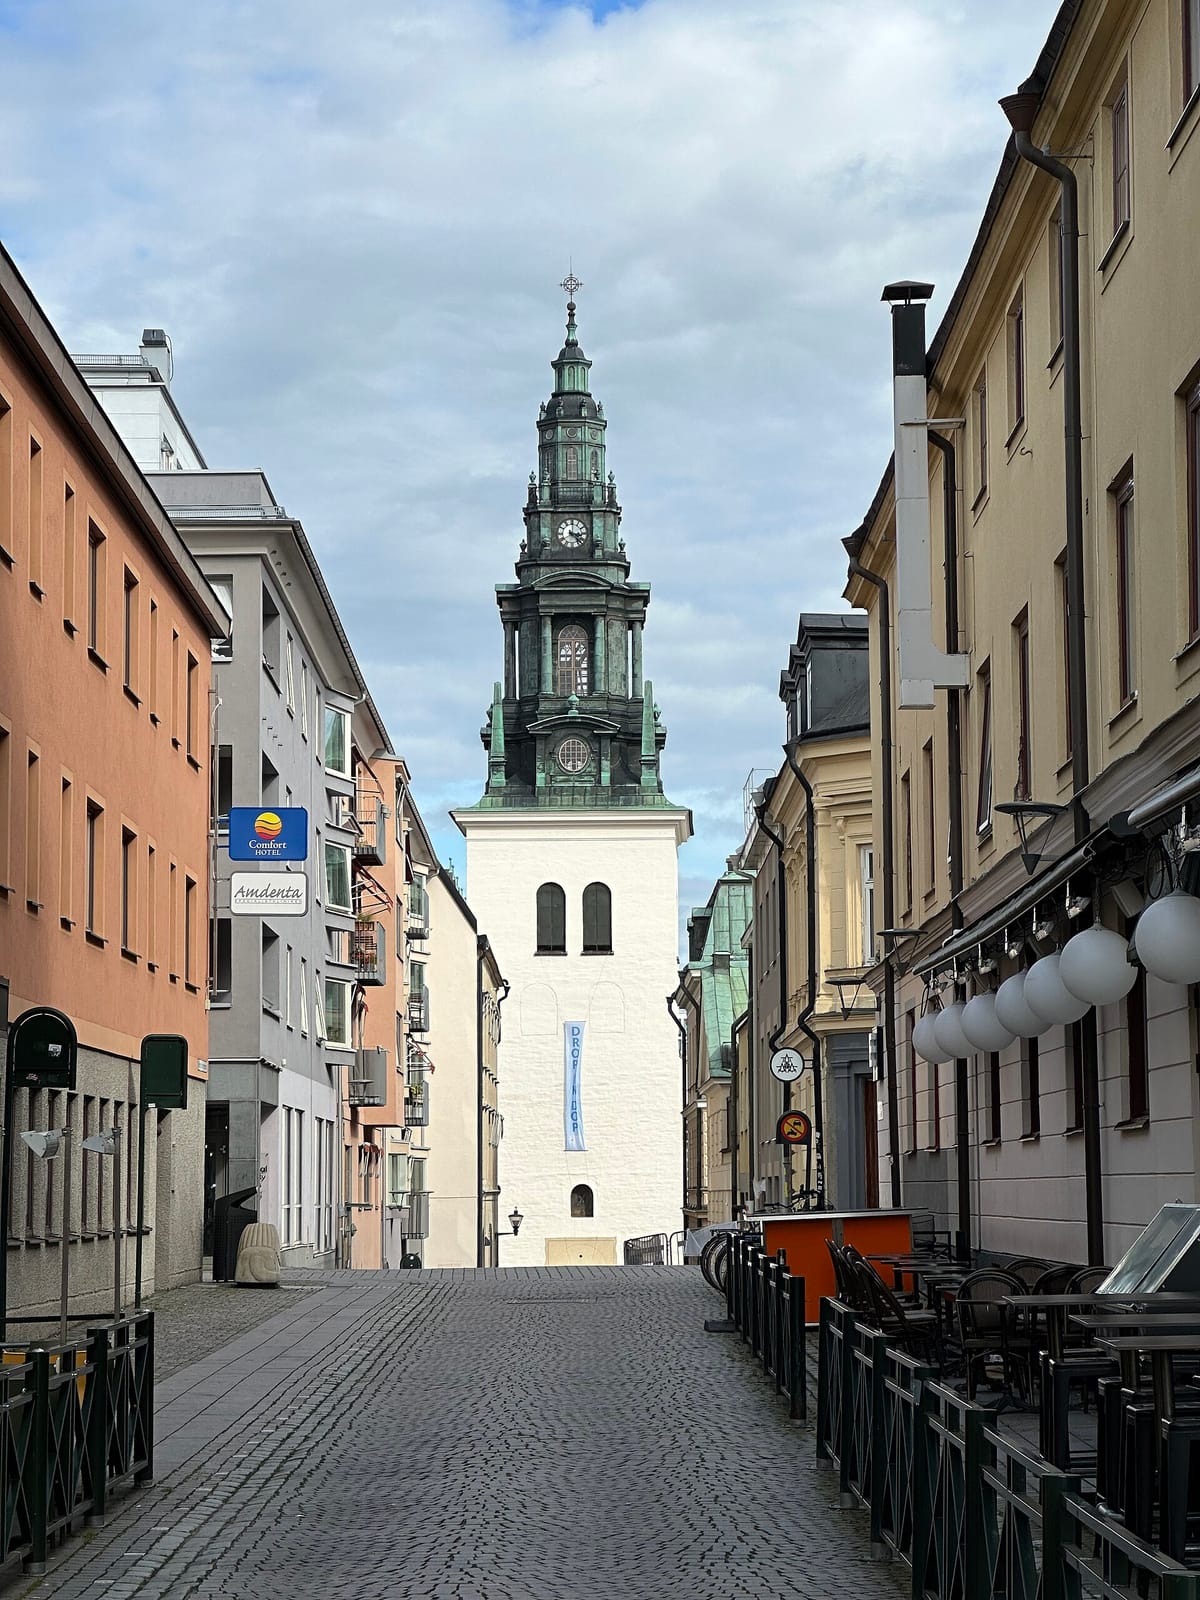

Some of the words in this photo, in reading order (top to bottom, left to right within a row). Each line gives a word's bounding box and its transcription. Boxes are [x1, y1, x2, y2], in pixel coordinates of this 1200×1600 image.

[248, 840, 287, 849] Comfort
[234, 883, 304, 899] Amdenta
[571, 1026, 580, 1069] DROP
